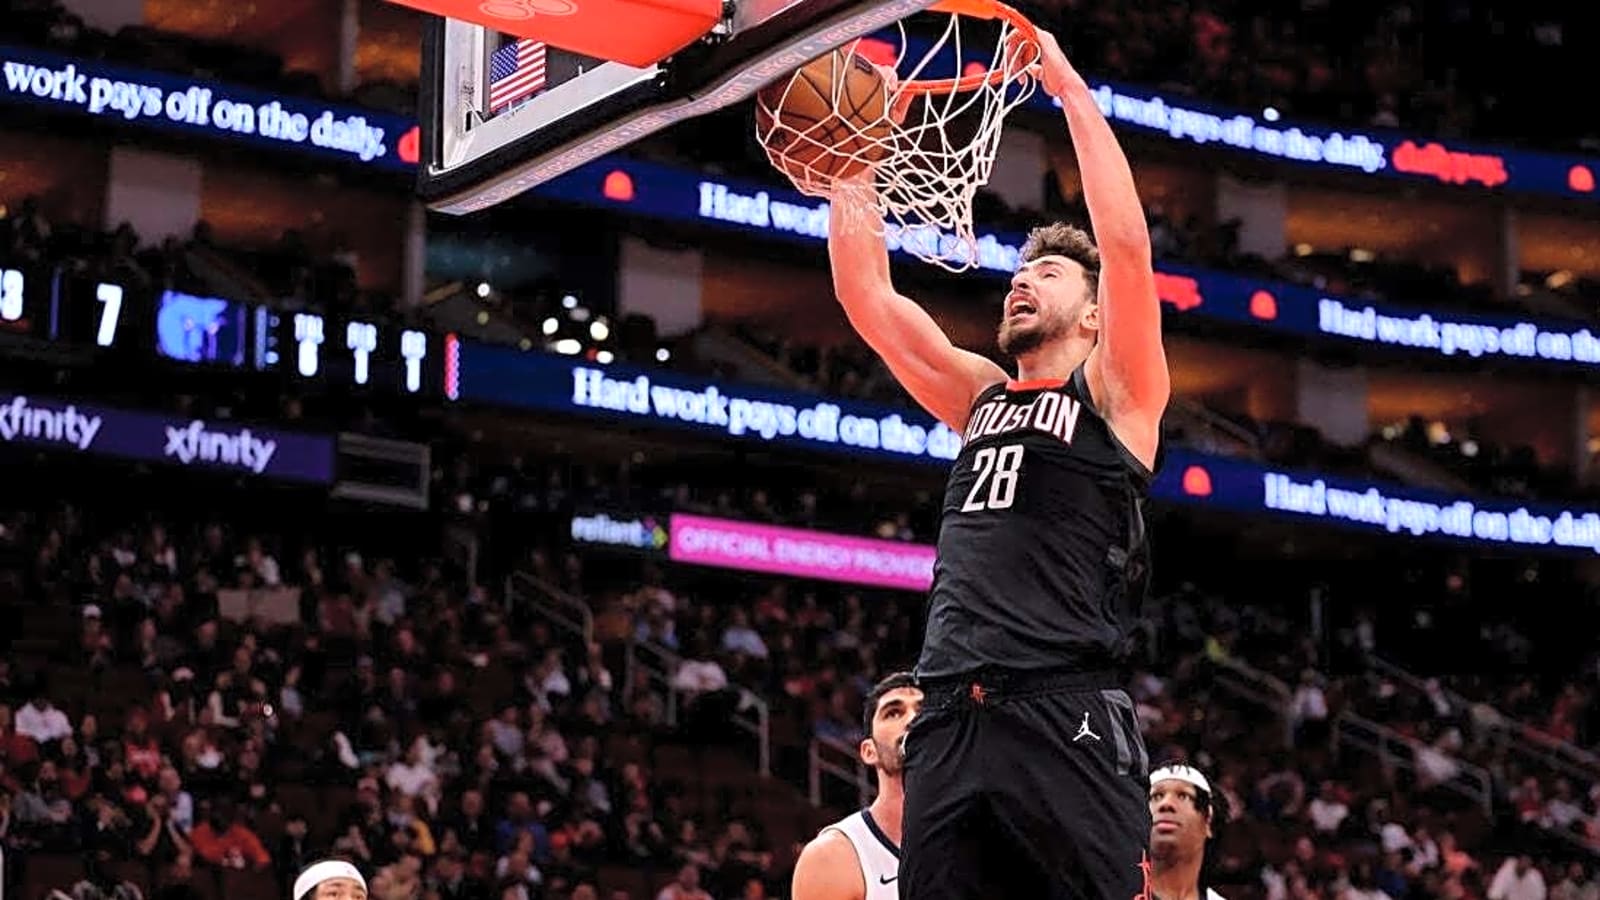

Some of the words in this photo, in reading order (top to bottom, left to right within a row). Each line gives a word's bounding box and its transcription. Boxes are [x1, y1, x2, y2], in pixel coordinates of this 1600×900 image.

[752, 50, 809, 82] Turkey
[3, 61, 87, 104] work
[88, 77, 163, 119] pays
[165, 86, 212, 125] off
[213, 100, 256, 134] on
[257, 101, 309, 142] the
[310, 110, 386, 162] daily.
[699, 182, 771, 228] Hard
[96, 282, 124, 347] 7
[1571, 328, 1600, 363] th
[573, 367, 650, 415] Hard
[650, 386, 728, 426] work
[728, 398, 797, 440] pays
[797, 402, 840, 442] off
[839, 414, 880, 448] on
[879, 414, 928, 455] the
[164, 420, 276, 474] xfinity
[960, 444, 1025, 513] 28
[677, 526, 770, 563] OFFICIAL
